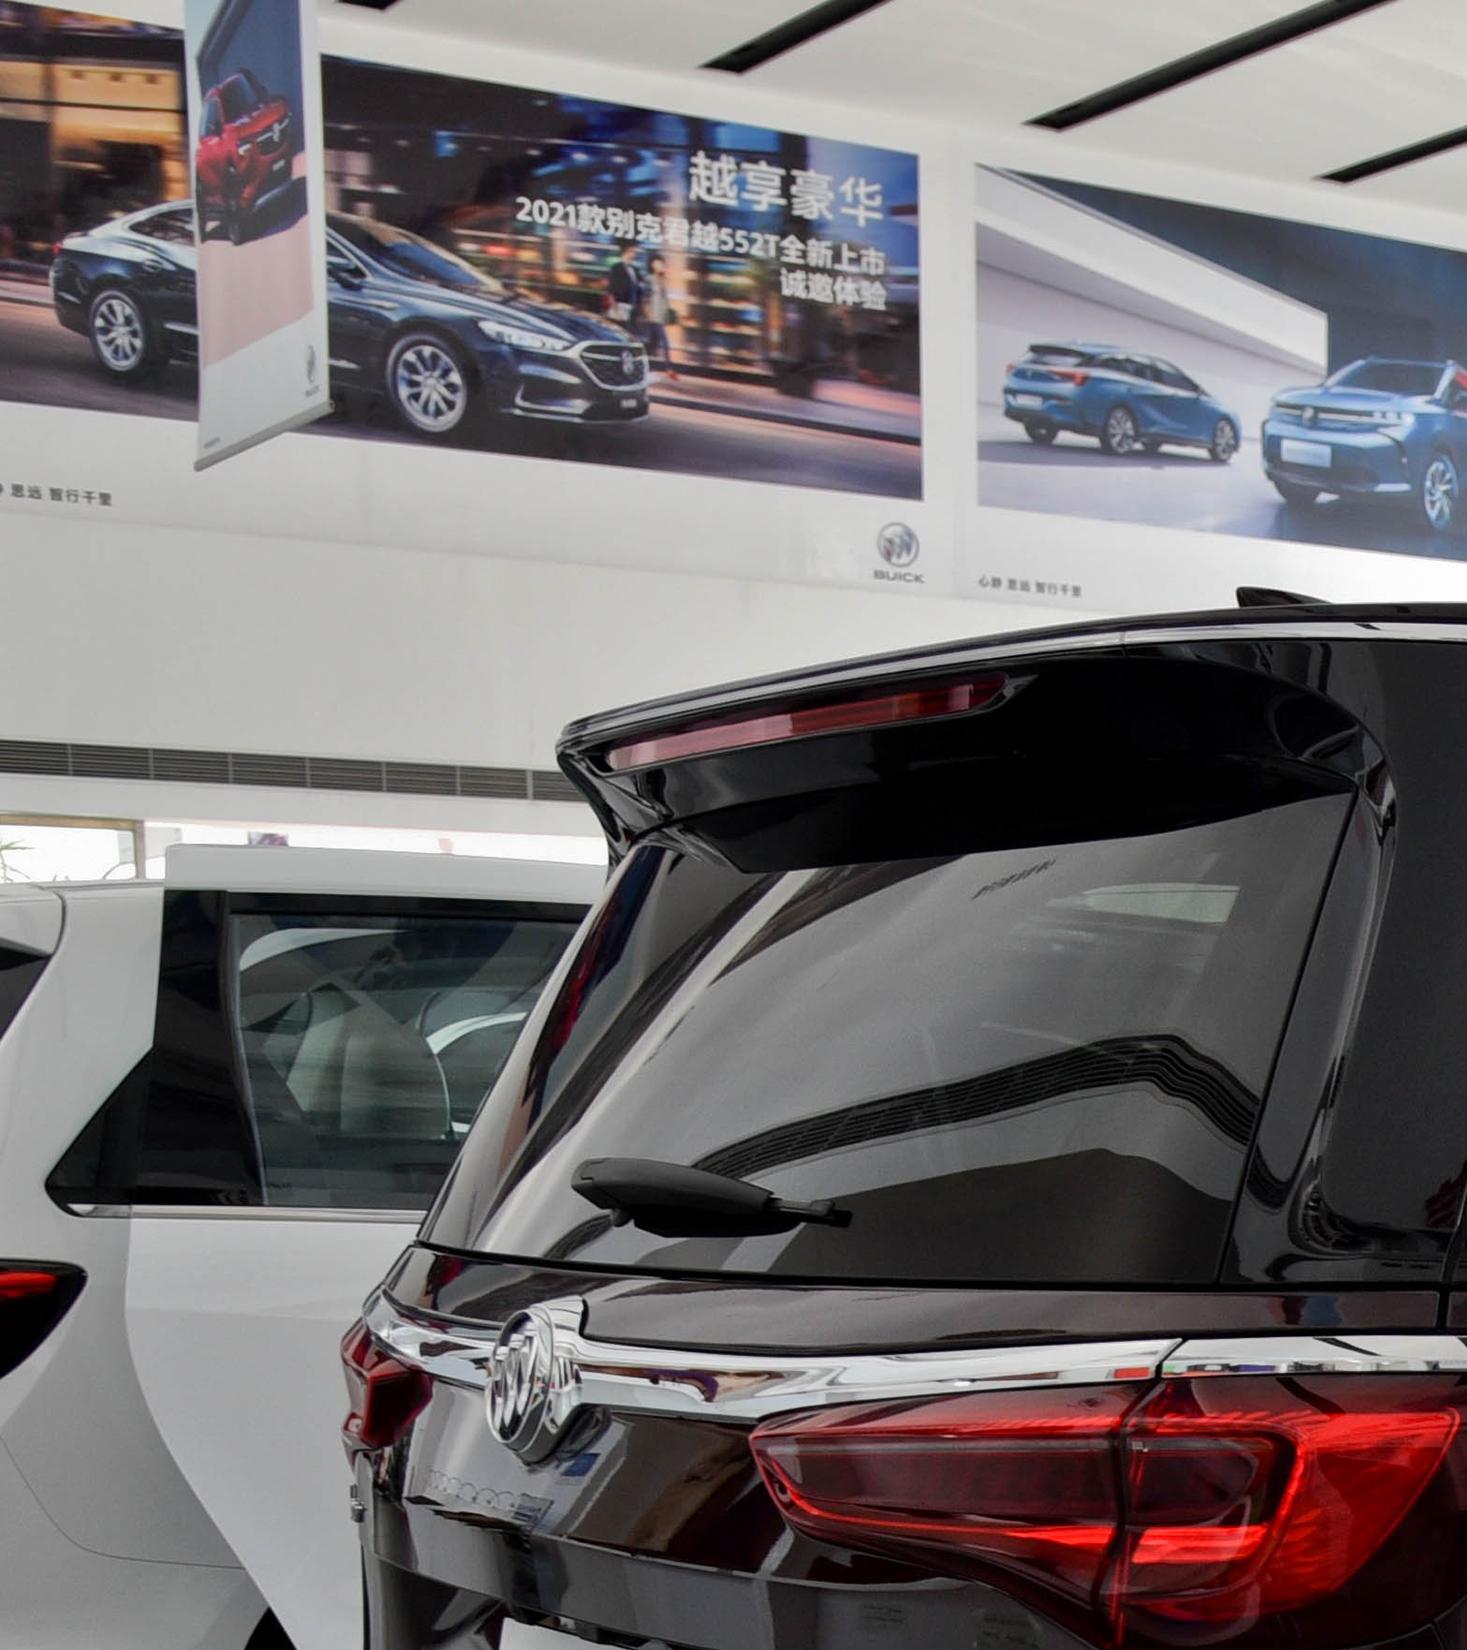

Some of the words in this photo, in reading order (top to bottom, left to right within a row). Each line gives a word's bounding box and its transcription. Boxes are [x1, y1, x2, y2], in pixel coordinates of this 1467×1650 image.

[689, 150, 884, 228] 越享豪华
[515, 196, 886, 276] 2021款别克君越552T全新上市
[780, 268, 887, 311] 诚邀体验
[873, 569, 926, 584] BUICK
